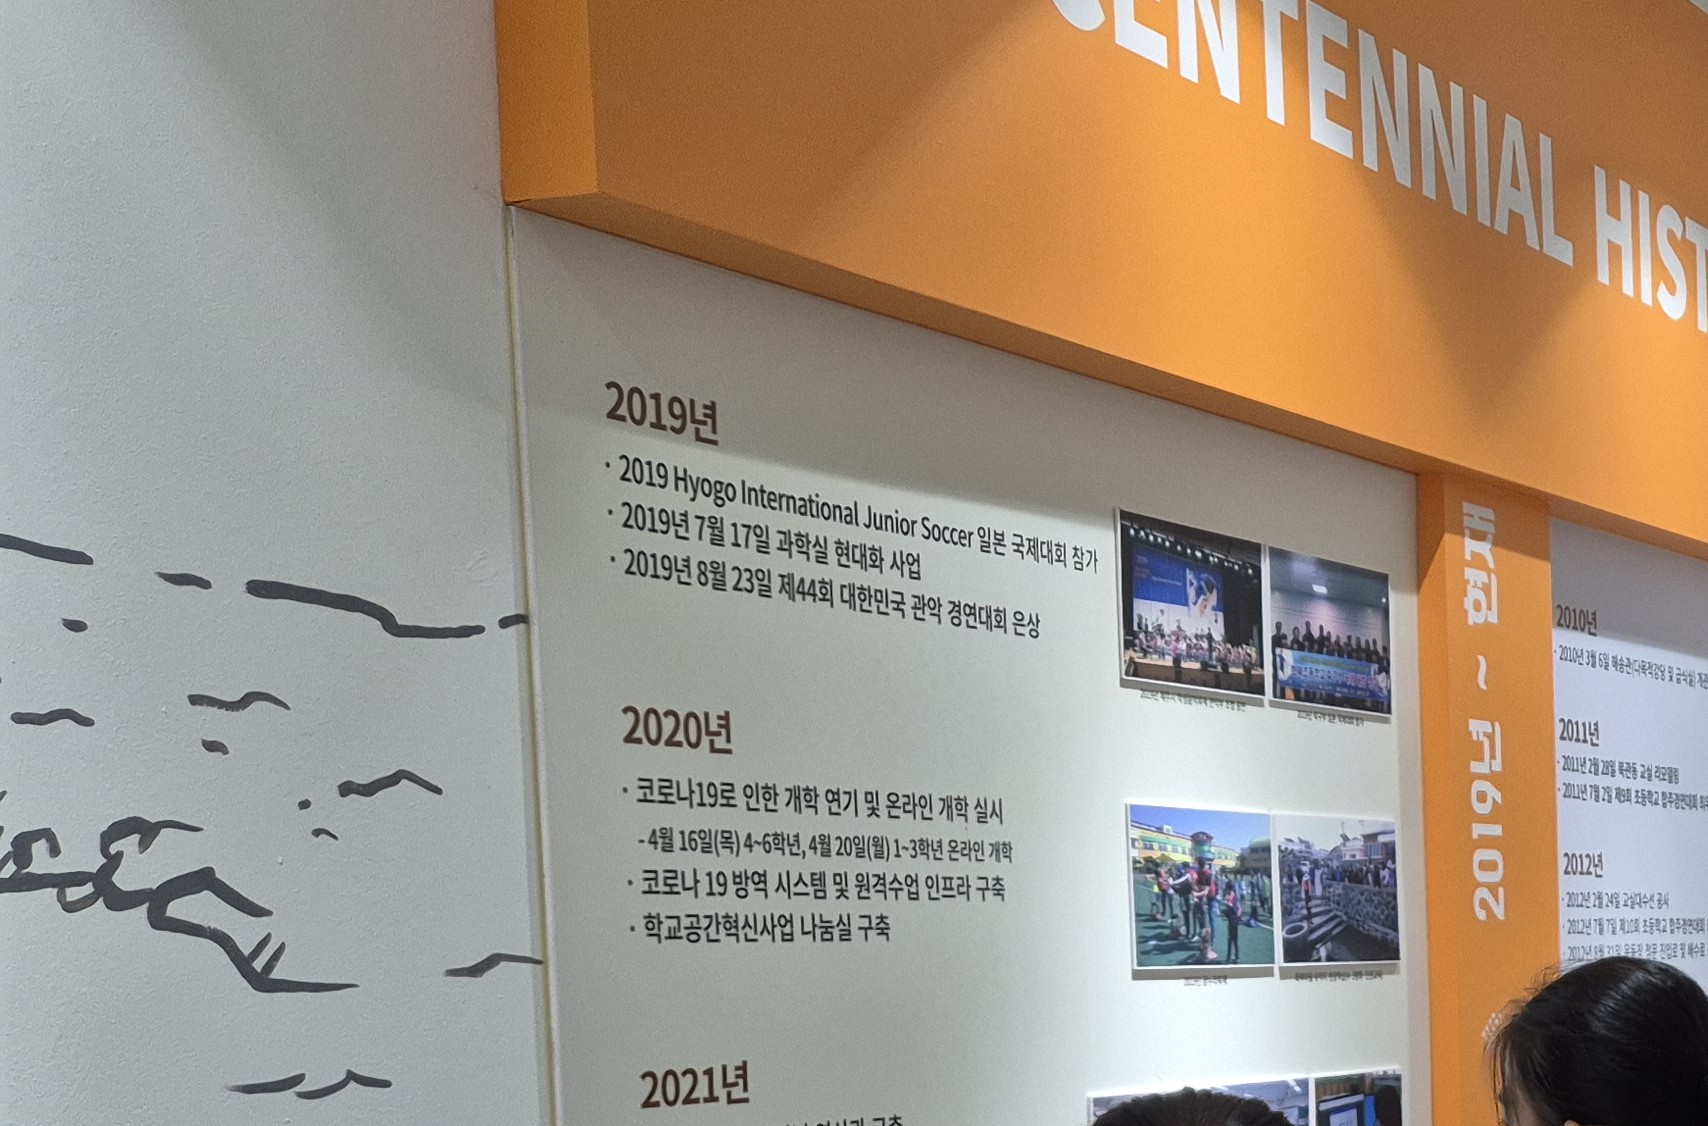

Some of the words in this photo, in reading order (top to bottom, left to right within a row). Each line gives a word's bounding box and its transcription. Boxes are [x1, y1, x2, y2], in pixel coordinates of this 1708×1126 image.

[604, 382, 718, 445] 2019년
[619, 456, 669, 490] 2019
[673, 467, 736, 507] Hyogo
[741, 480, 860, 527] International
[863, 506, 917, 537] Junior
[921, 519, 974, 550] Soccer
[977, 526, 1007, 555] 일본
[1011, 533, 1067, 568] 국제대회
[1071, 545, 1098, 574] 참가
[621, 502, 690, 542] 2019년
[695, 514, 725, 548] 7월
[731, 522, 771, 555] 17일
[776, 529, 829, 566] 과학실
[835, 539, 884, 575] 현대화
[890, 549, 921, 581] 사업
[1463, 502, 1498, 625] 현재
[623, 548, 691, 587] 2019년
[697, 560, 728, 592] 8월
[732, 565, 772, 599] 23일
[778, 572, 834, 609] 제44회
[840, 582, 906, 619] 대한민국
[911, 593, 942, 625] 관악
[947, 598, 1008, 635] 경연대회
[1012, 610, 1040, 640] 은상
[1556, 604, 1597, 637] 2010년
[621, 705, 733, 755] 2020년
[1559, 717, 1599, 746] 2011년
[636, 777, 735, 808] 코로나19로
[742, 782, 778, 813] 인한
[784, 785, 819, 817] 개학
[824, 788, 859, 817] 연기
[864, 790, 880, 819] 및
[885, 792, 933, 822] 온라인
[938, 795, 969, 823] 개학
[973, 797, 1003, 825] 실시
[1468, 718, 1505, 921] 2019년
[678, 827, 741, 857] 16일(목)
[809, 834, 832, 858] 4월
[835, 835, 890, 863] 20일(월)
[893, 836, 944, 862] 1~3학년
[947, 840, 985, 863] 온라인
[989, 841, 1013, 864] 개학
[1563, 852, 1603, 878] 2012년
[641, 868, 700, 898] 코로나
[705, 871, 728, 896] 19
[732, 869, 768, 899] 방역
[775, 870, 826, 899] 시스템
[832, 872, 849, 899] 및
[855, 871, 920, 901] 원격수업
[925, 874, 970, 901] 인프라
[975, 875, 1005, 902] 구축
[643, 912, 795, 944] 학교공간혁신사업
[799, 913, 852, 942] 나눔실
[857, 914, 890, 942] 구축
[640, 1060, 750, 1109] 2021년
